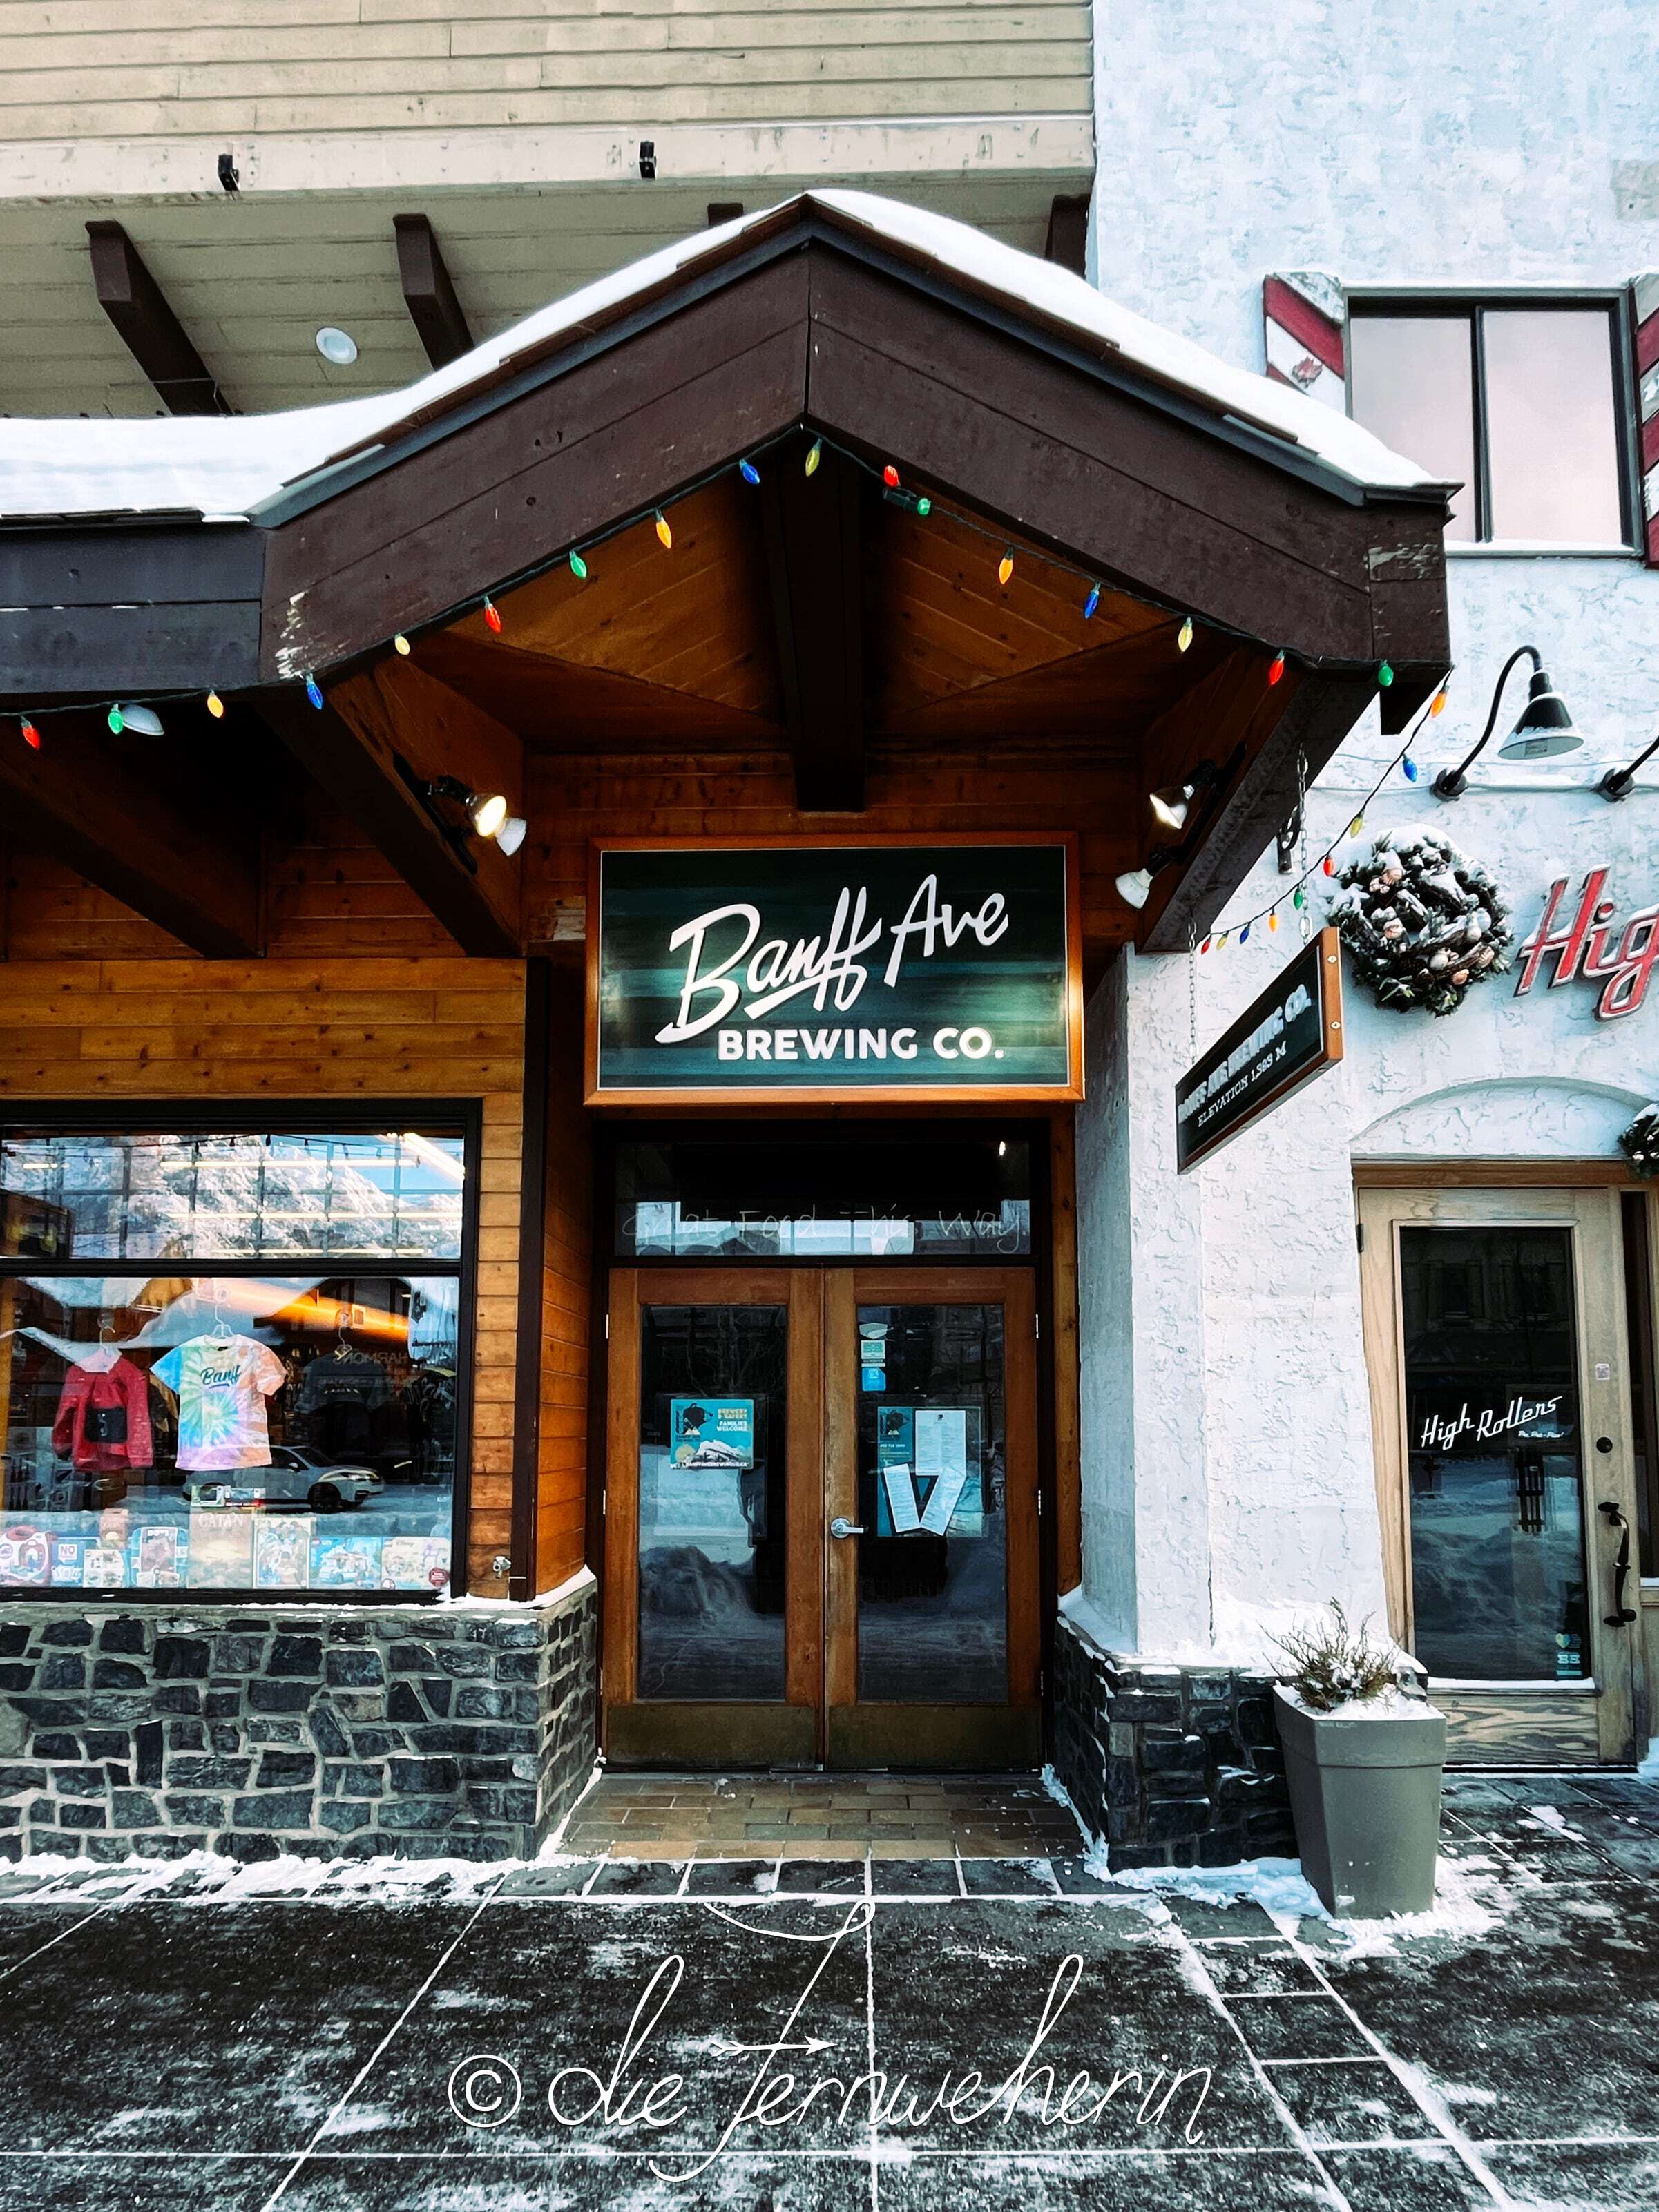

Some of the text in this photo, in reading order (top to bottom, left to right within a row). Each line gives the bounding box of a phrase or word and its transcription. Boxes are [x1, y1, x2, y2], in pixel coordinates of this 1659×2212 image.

[654, 874, 1010, 1044] Banff Ave
[718, 1026, 1006, 1061] BREWING CO.
[1197, 1075, 1249, 1128] ELEVATION
[1275, 1040, 1287, 1061] M
[622, 1209, 719, 1243] Grat
[839, 1203, 920, 1238] Thi
[1420, 1396, 1564, 1451] High Rollers
[198, 1512, 244, 1528] CATAN
[60, 1546, 76, 1555] NO
